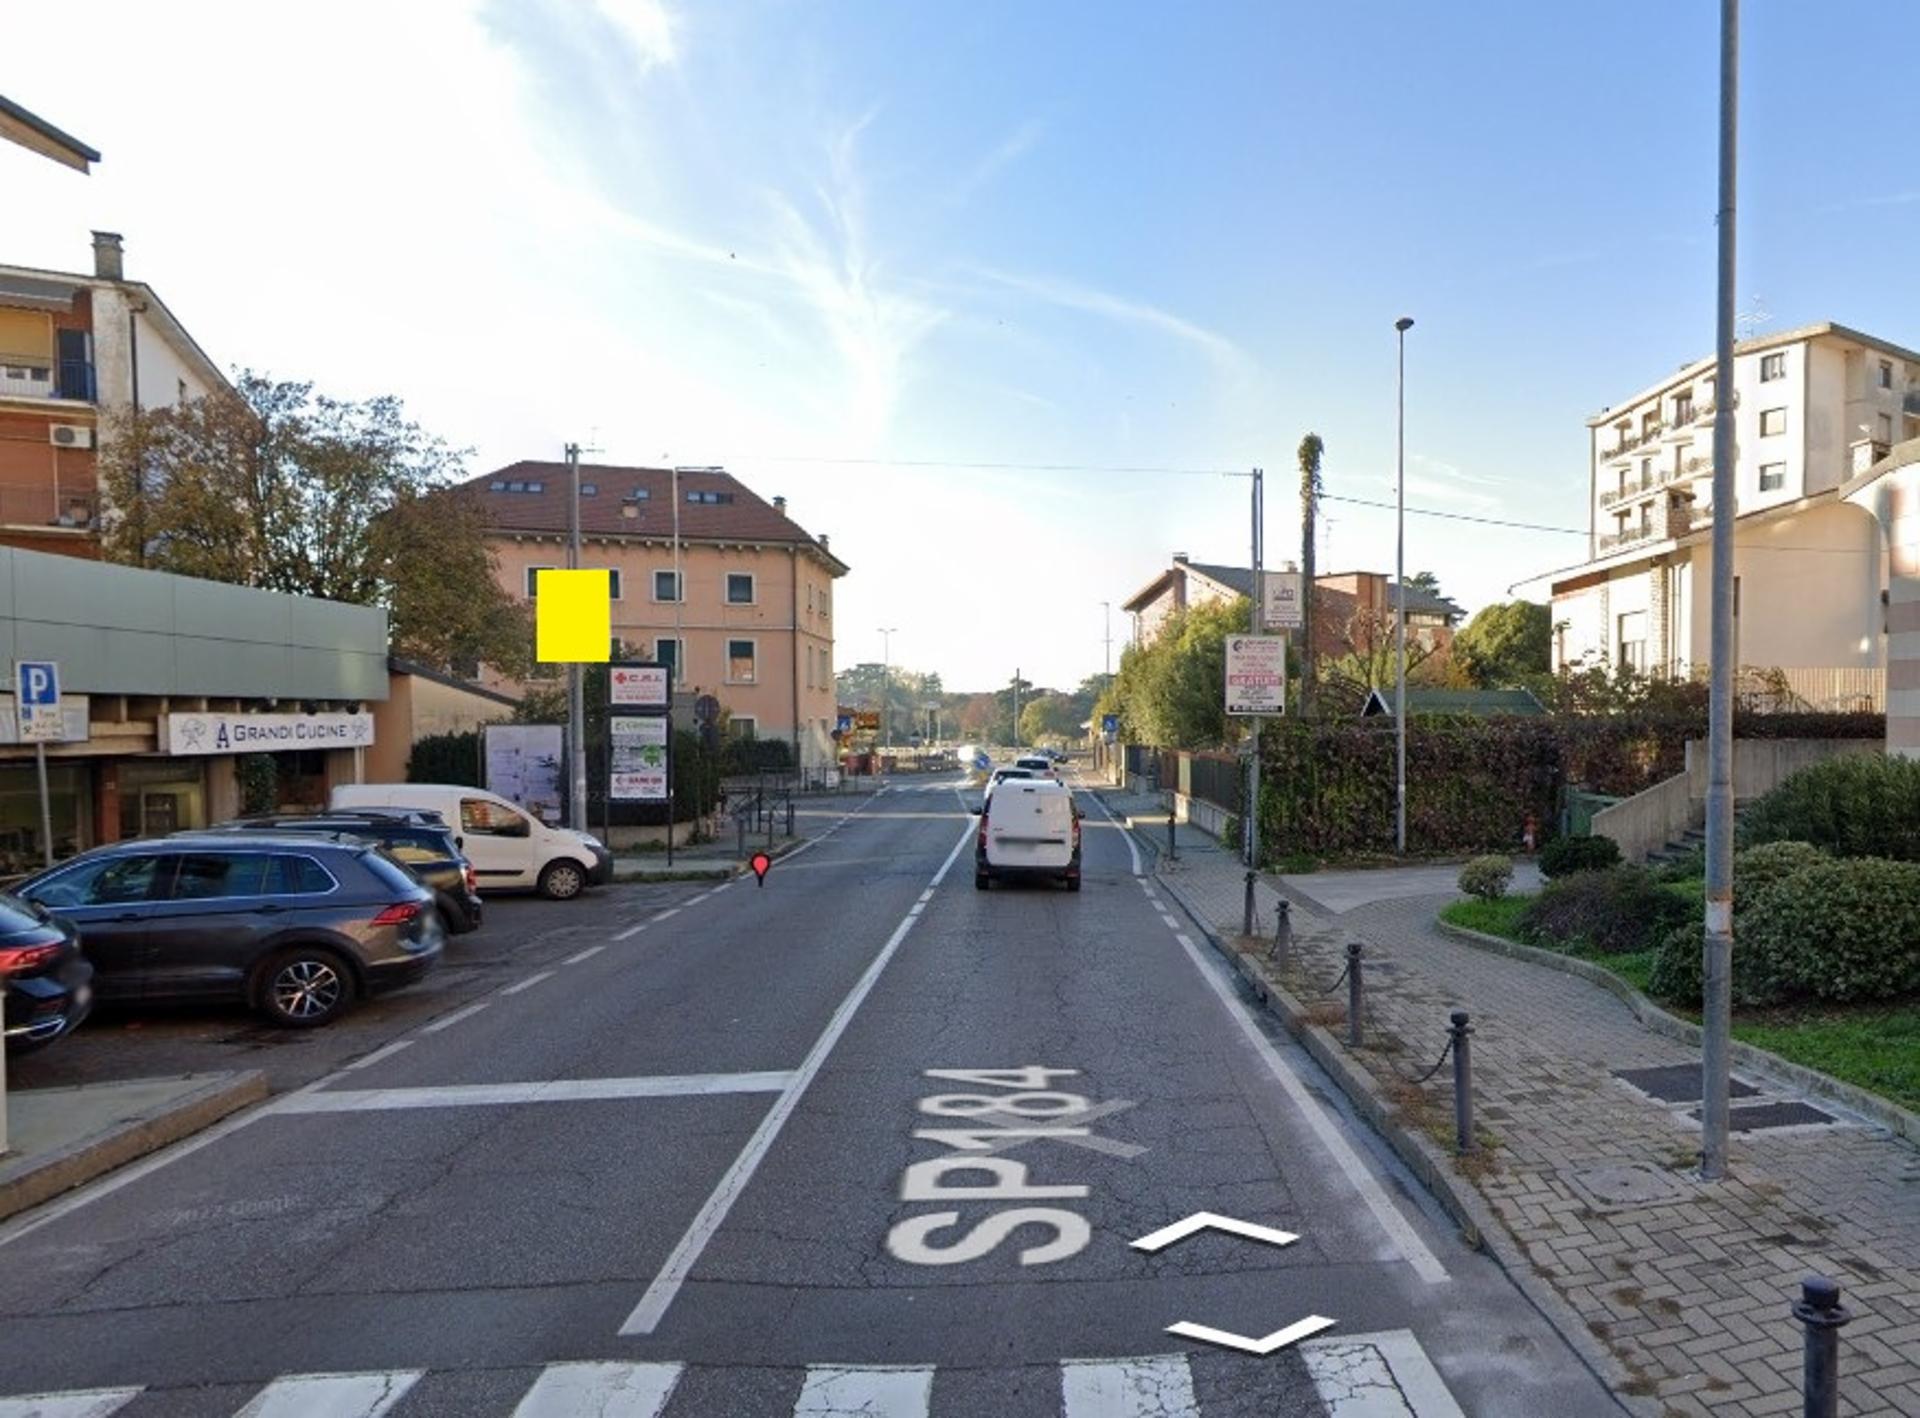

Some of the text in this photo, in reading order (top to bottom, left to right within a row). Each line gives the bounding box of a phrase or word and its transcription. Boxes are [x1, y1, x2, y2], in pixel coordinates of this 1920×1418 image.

[29, 668, 47, 700] P
[216, 723, 347, 748] A GRANDI CUCINE
